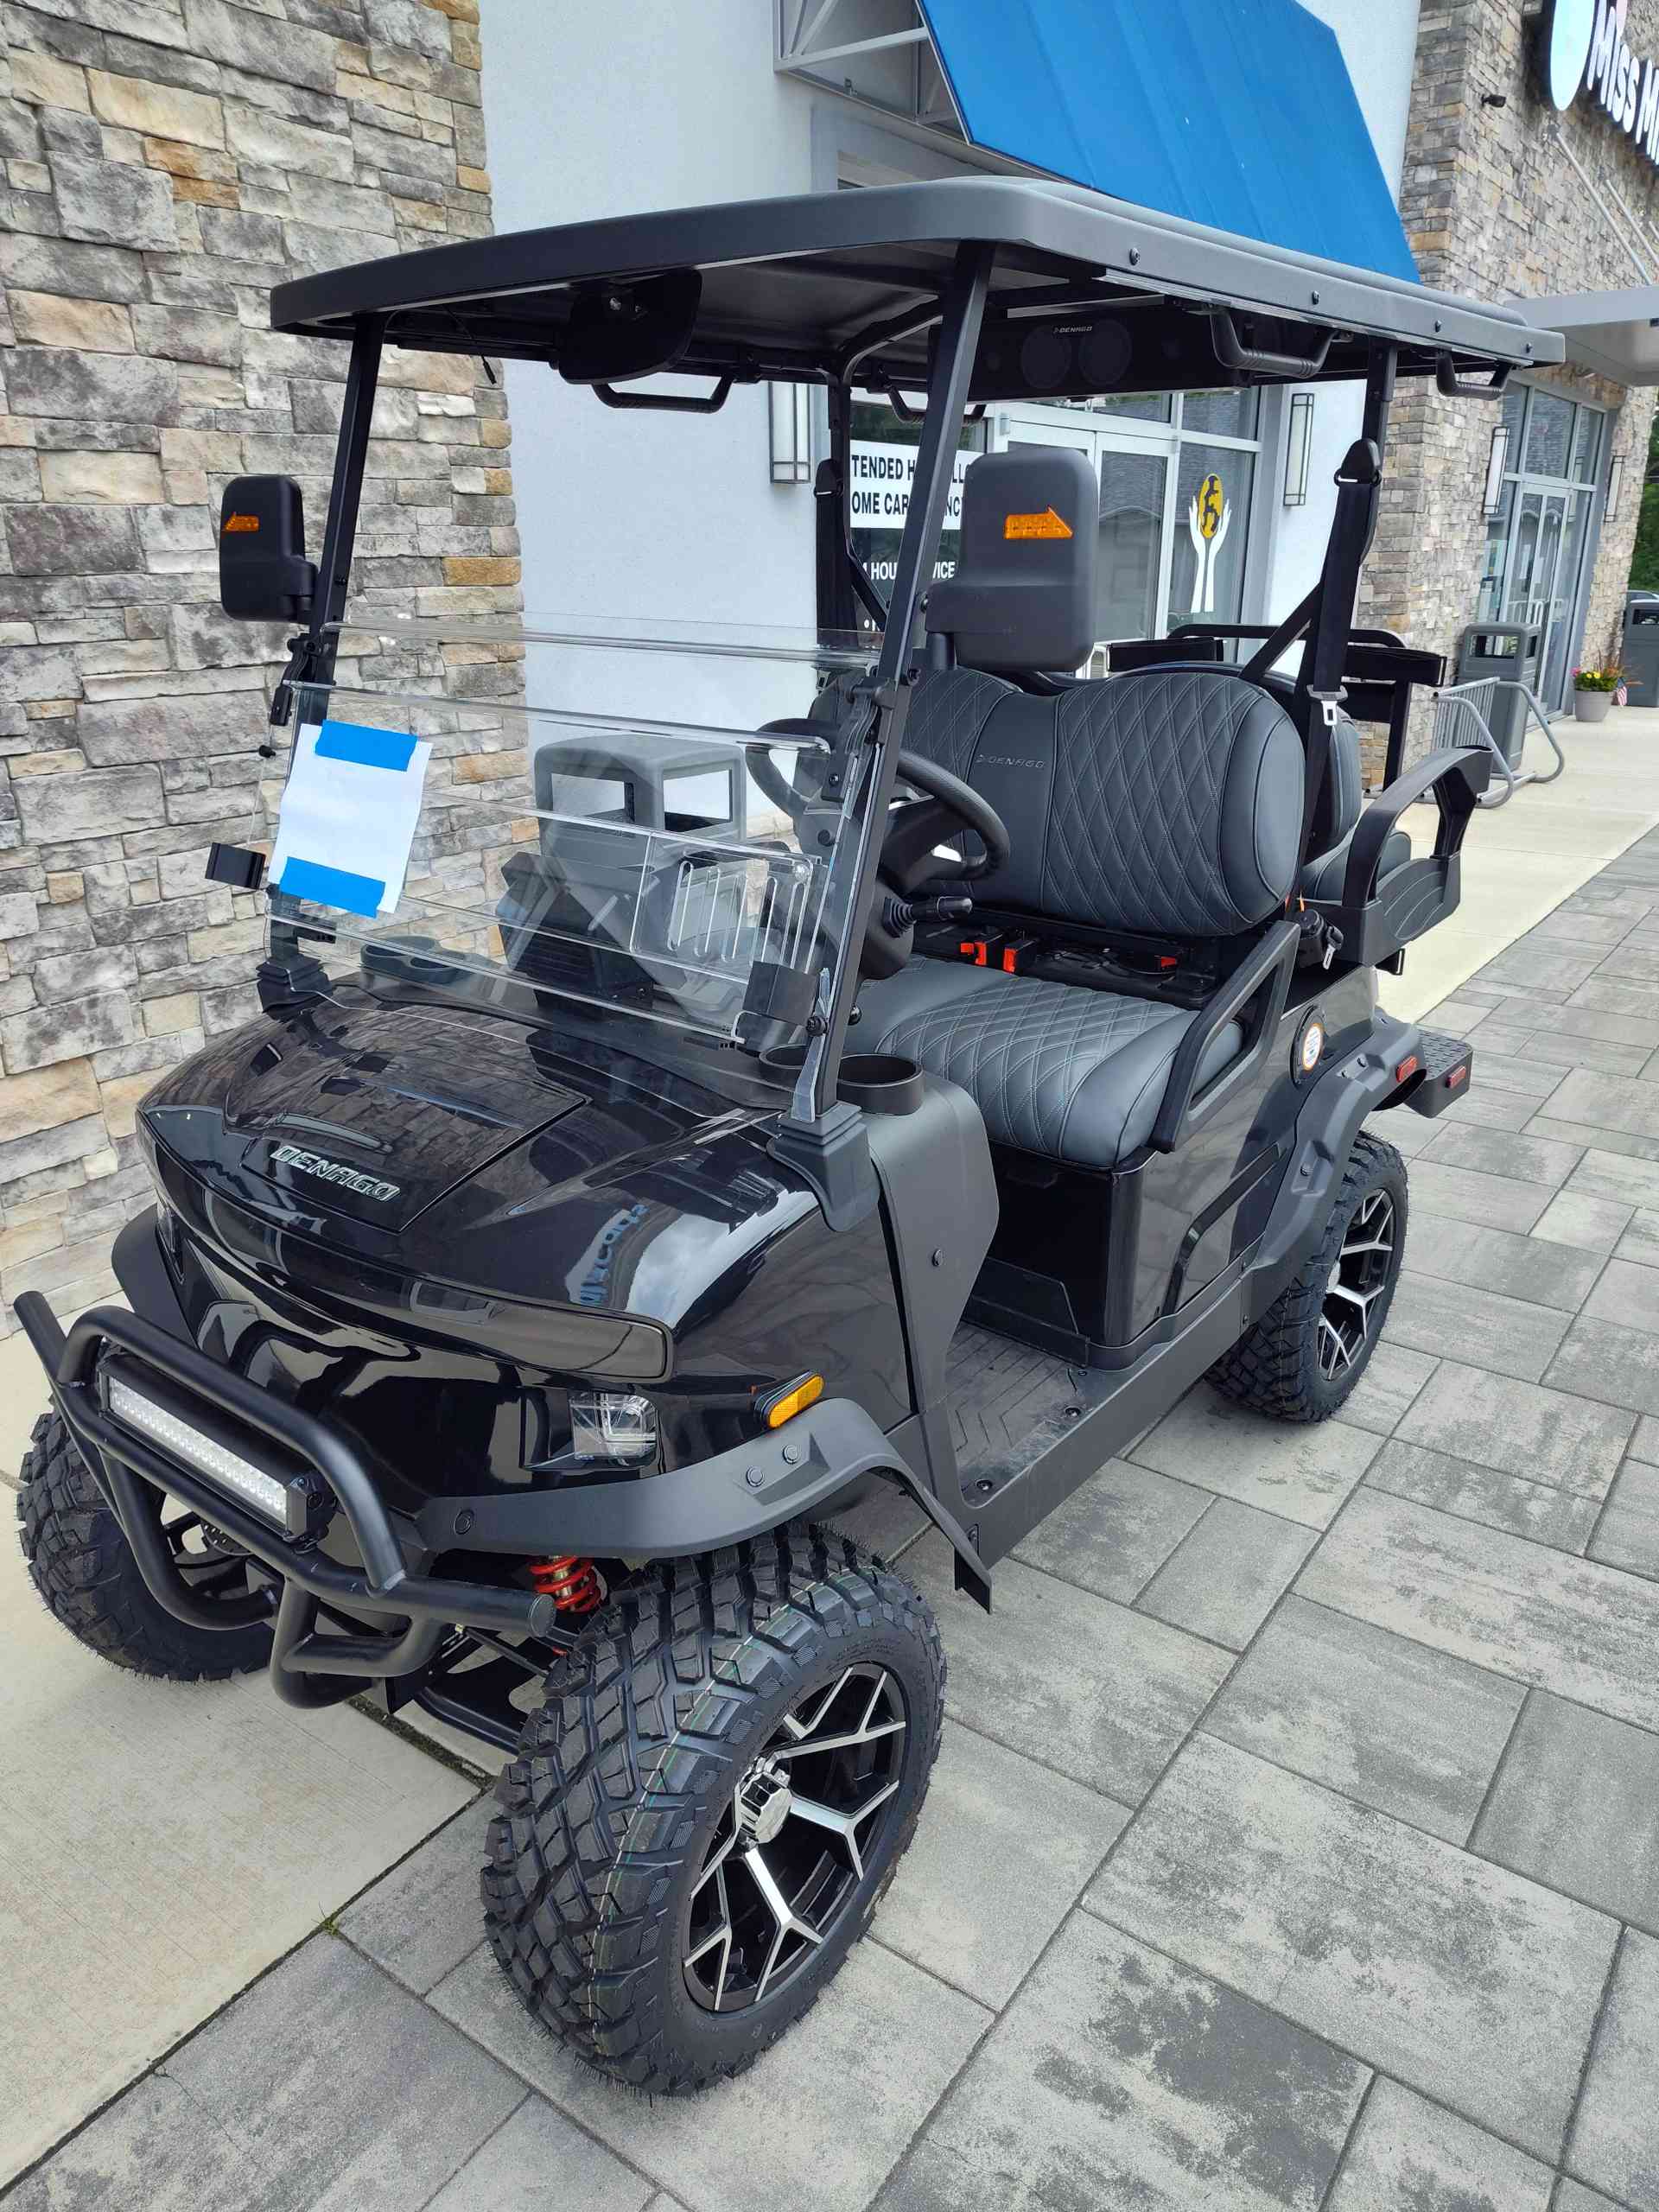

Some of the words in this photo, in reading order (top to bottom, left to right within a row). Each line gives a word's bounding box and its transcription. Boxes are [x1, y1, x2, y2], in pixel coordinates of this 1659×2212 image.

[851, 454, 904, 480] TENDED
[851, 491, 880, 514] OME
[884, 493, 909, 515] CAR
[870, 562, 897, 580] HOU
[270, 1145, 401, 1202] DENAGO
